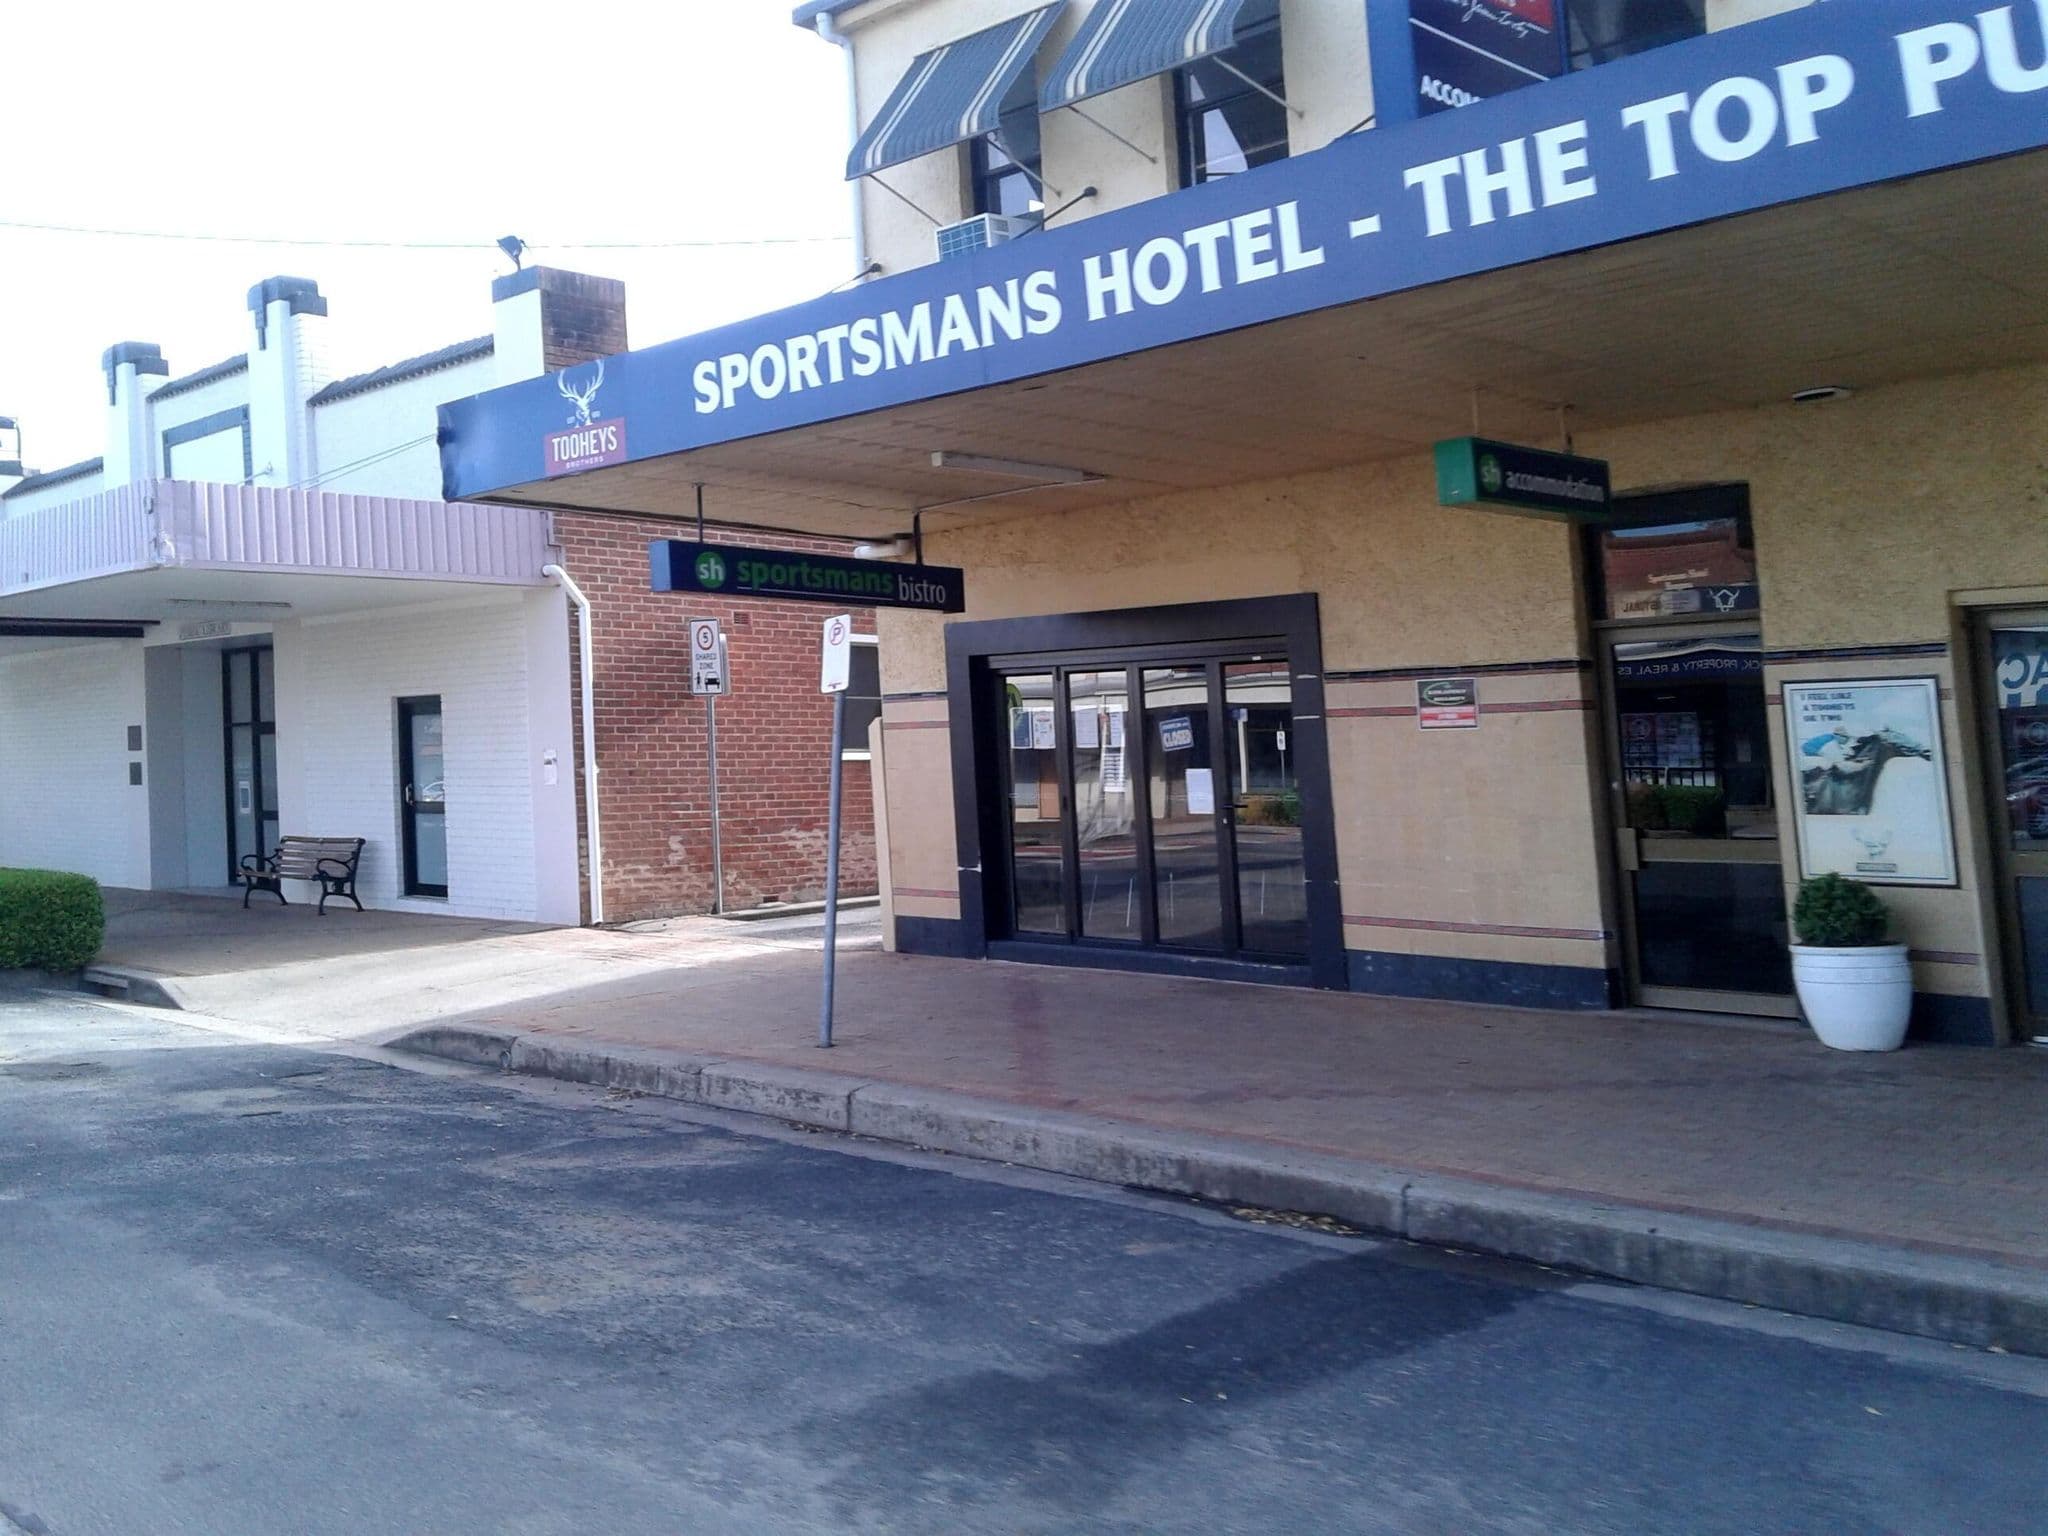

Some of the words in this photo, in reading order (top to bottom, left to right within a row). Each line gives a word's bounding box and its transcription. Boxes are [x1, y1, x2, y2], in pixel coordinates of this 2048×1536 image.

[693, 269, 1063, 414] SPORTSMANS
[1082, 201, 1326, 321] HOTEL
[1404, 119, 1597, 237] THE
[1621, 54, 1856, 181] TOP
[552, 426, 617, 461] TOOHEYS
[699, 559, 725, 582] sh
[736, 560, 894, 593] sportsmans
[897, 574, 946, 604] bistro
